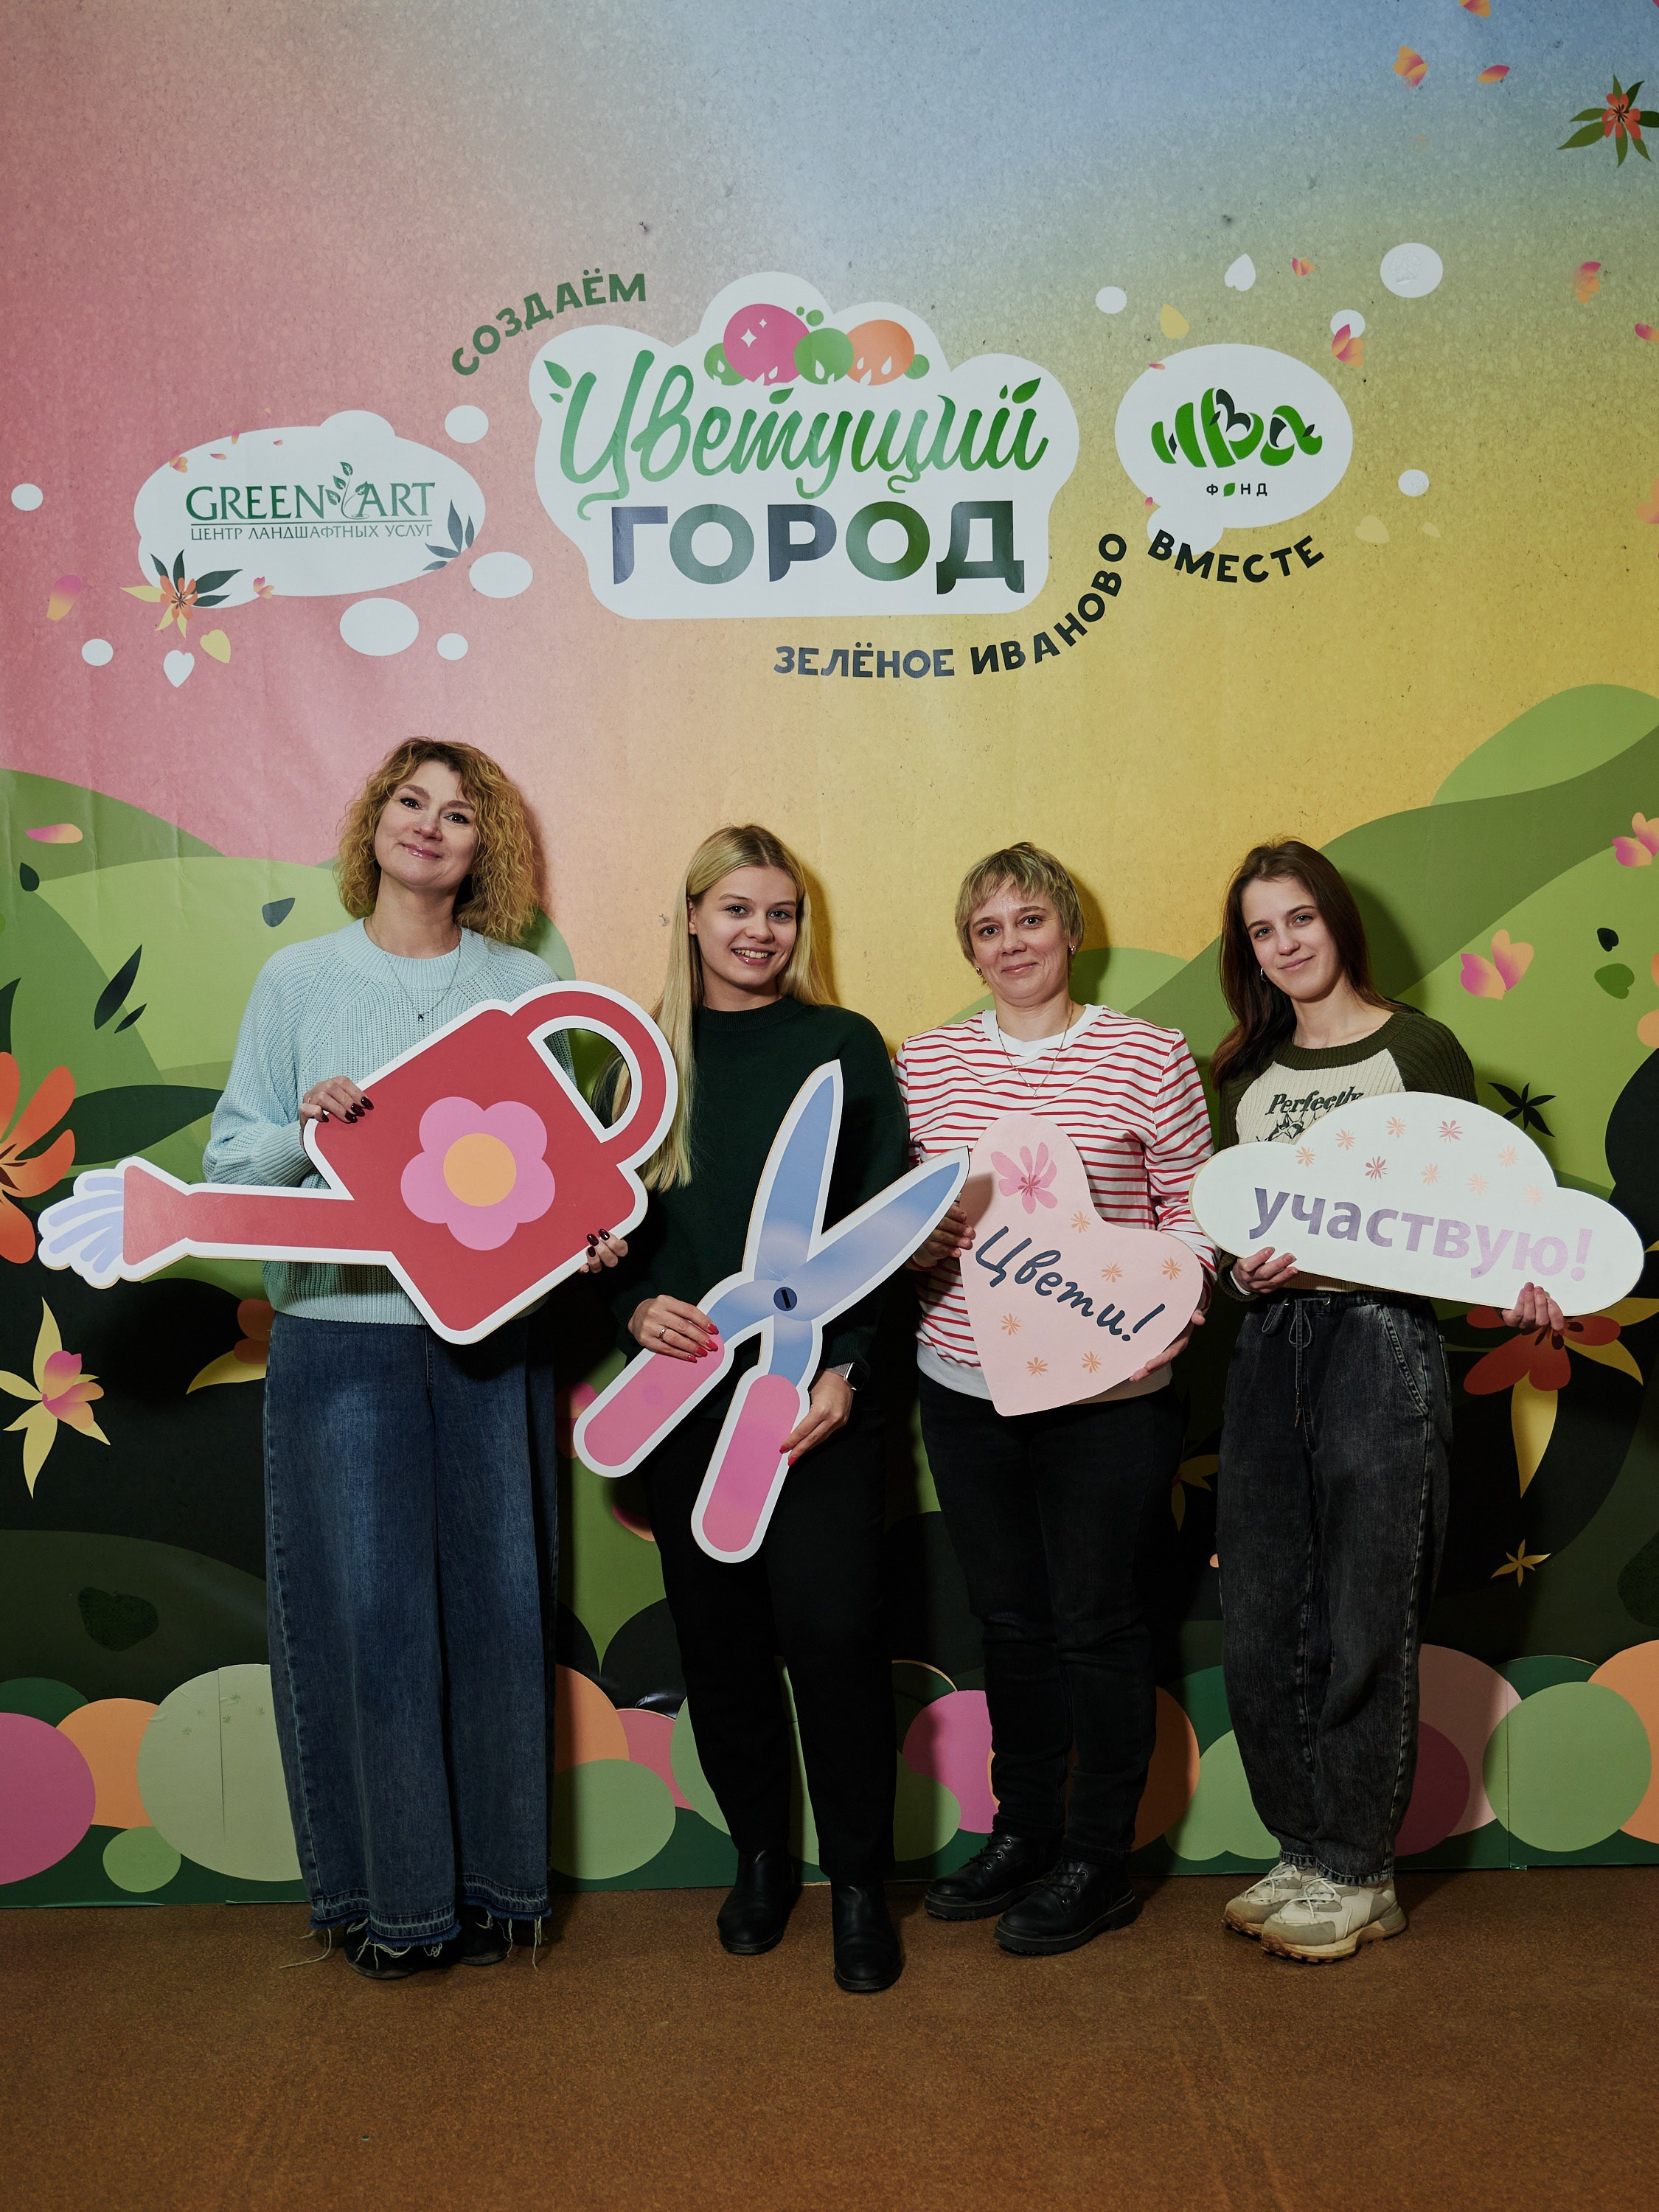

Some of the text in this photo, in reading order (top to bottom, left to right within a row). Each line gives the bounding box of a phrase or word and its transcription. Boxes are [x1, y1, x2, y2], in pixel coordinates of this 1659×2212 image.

[452, 270, 647, 376] СОЗДАЁМ
[554, 350, 1050, 521] Цветущий
[186, 481, 436, 521] GREEN ART
[190, 524, 433, 540] ЦЕНТР ЛАНДШАФТНЫХ УСЛУГ
[611, 501, 1025, 594] ГОРОД
[773, 529, 1324, 678] ЗЕЛЁНОЕ ИВАНОВО ВМЕСТЕ
[974, 1225, 1166, 1342] Цвети!
[1248, 1186, 1593, 1282] участвую!
